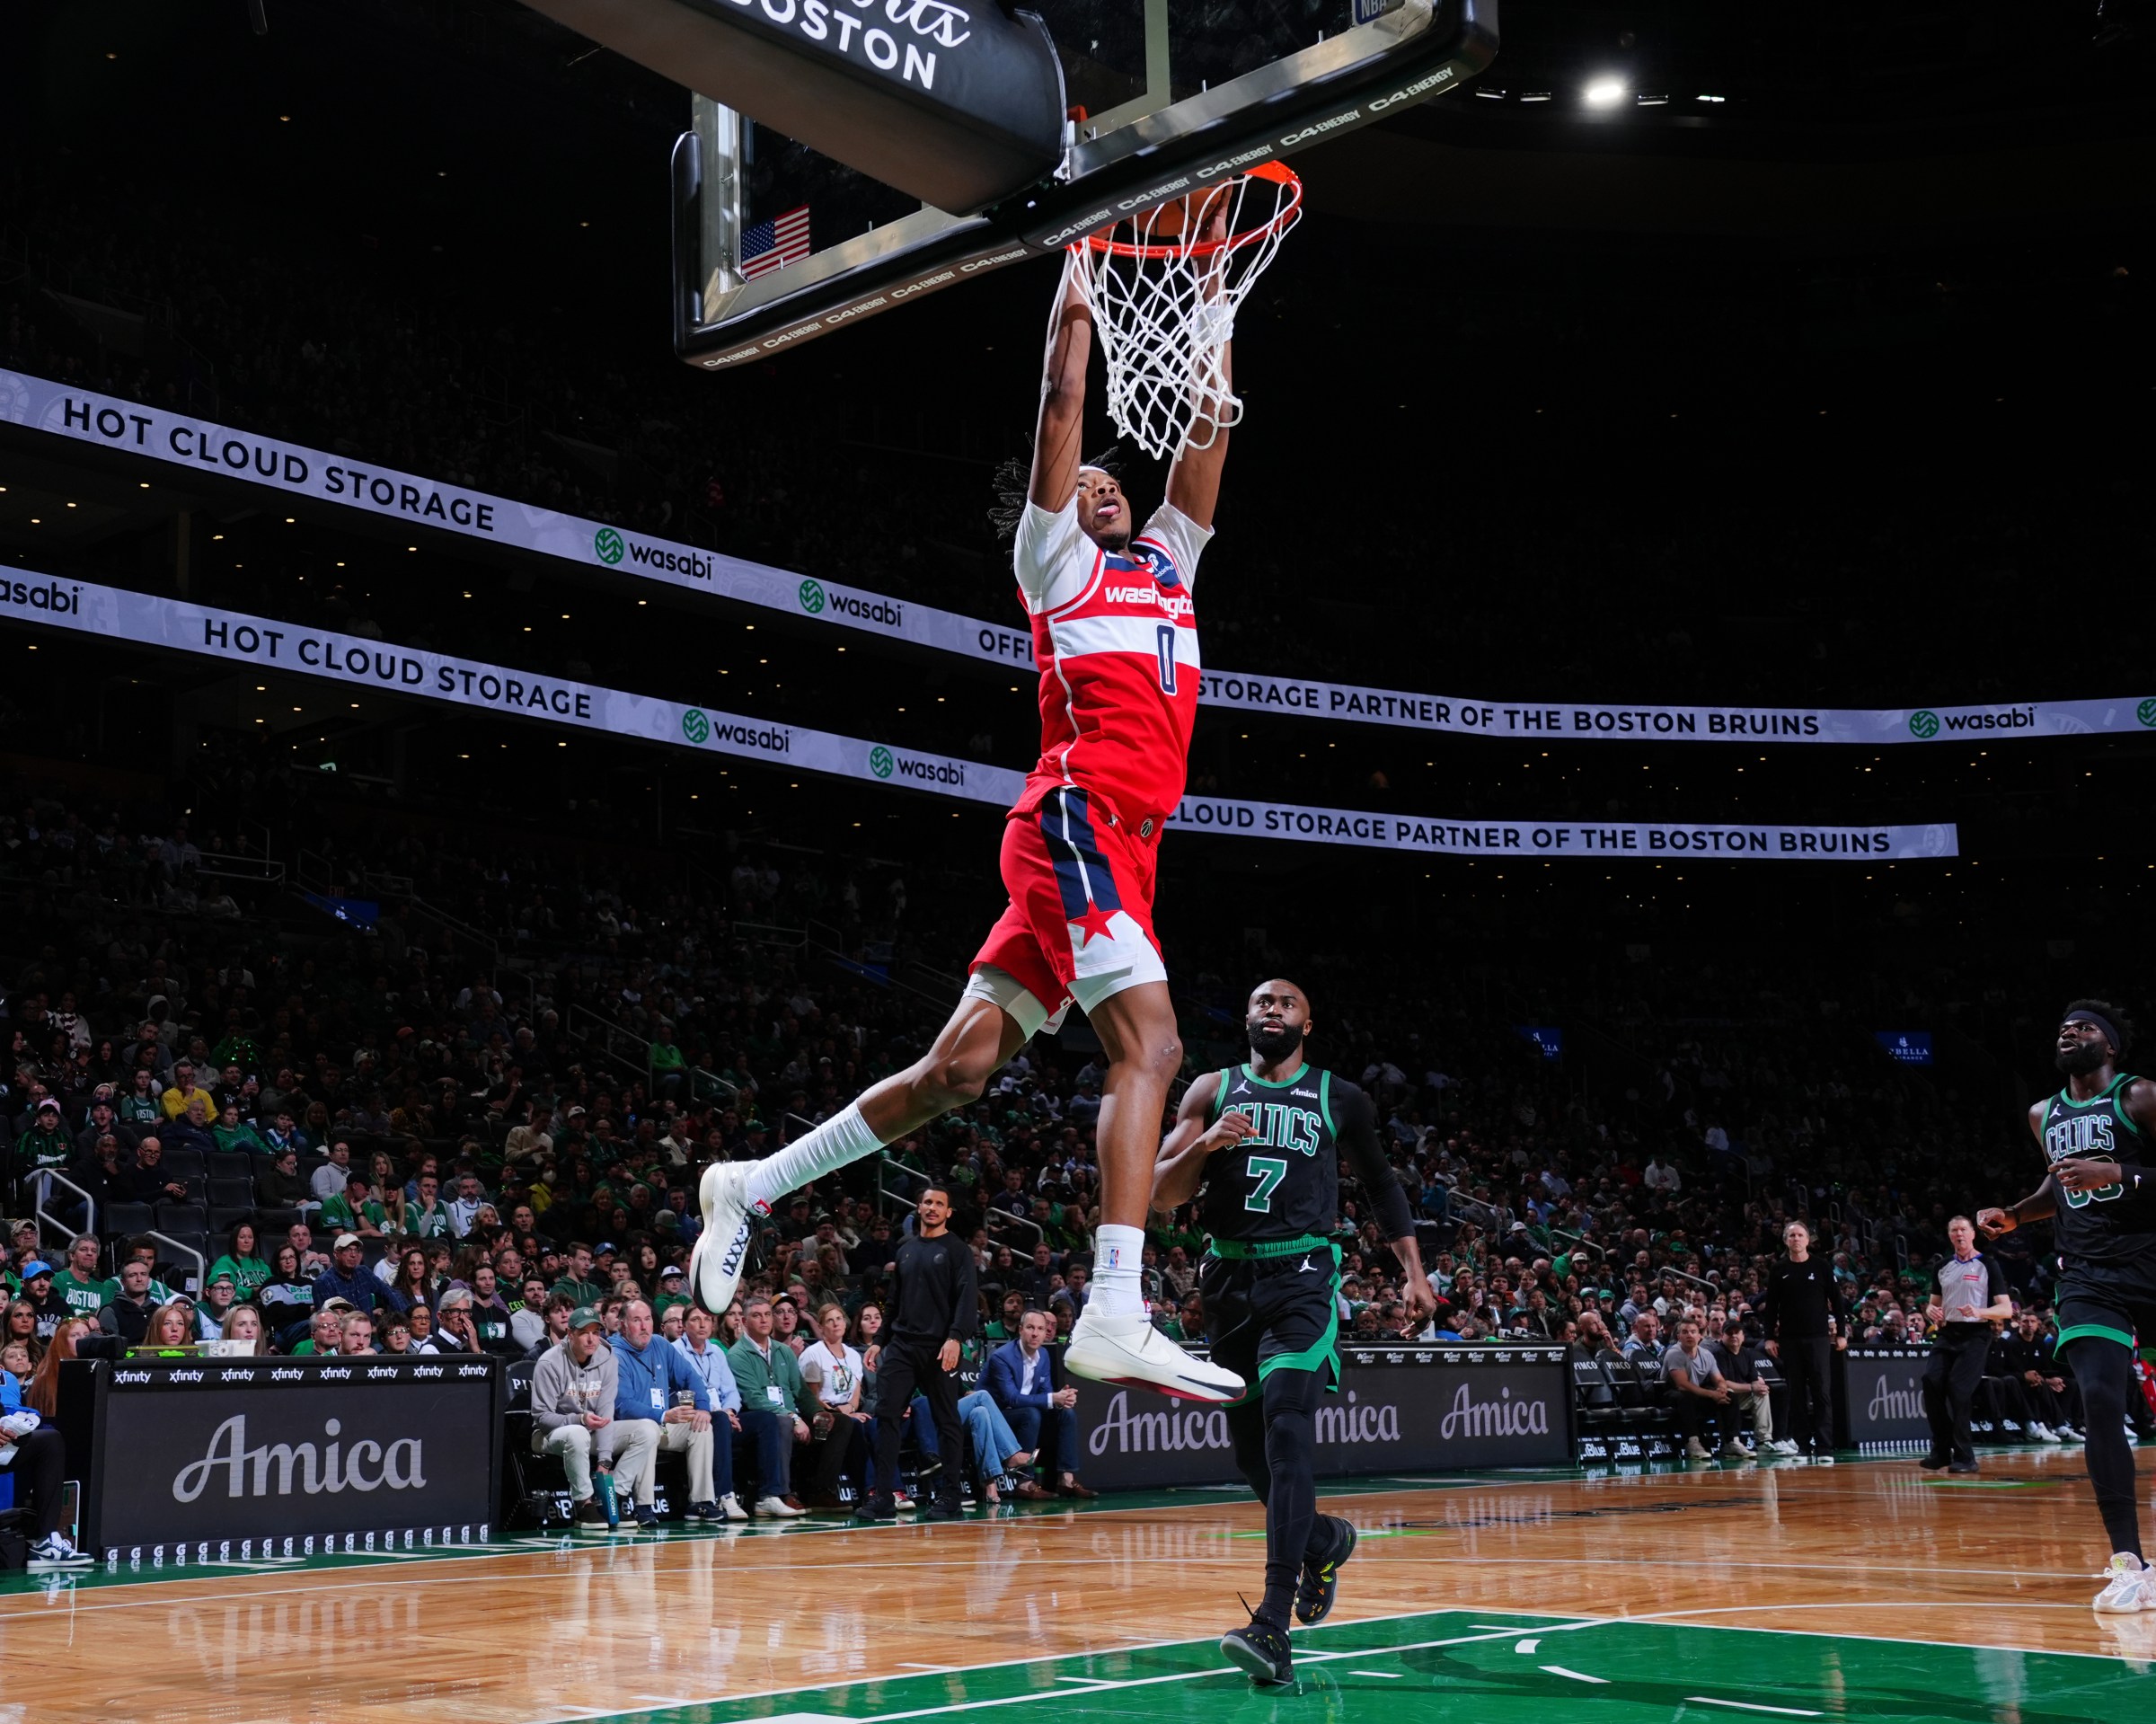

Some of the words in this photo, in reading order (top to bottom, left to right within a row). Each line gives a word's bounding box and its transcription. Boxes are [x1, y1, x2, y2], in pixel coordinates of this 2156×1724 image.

[730, 0, 936, 90] OSTON
[1368, 91, 1409, 112] C4
[1406, 66, 1454, 94] ENERGY
[1279, 127, 1319, 146] C4
[1316, 110, 1361, 134] ENERGY
[1196, 162, 1233, 180] C4
[1231, 145, 1274, 167] ENERGY
[1118, 194, 1153, 211] C4
[1150, 177, 1190, 199] ENERGY
[1043, 228, 1076, 246] C4
[1073, 208, 1112, 233] ENERGY
[959, 258, 992, 272] C4
[989, 248, 1028, 265] ENERGY
[891, 284, 922, 298] C4
[919, 270, 955, 288] ENERGY
[826, 311, 854, 323] C4
[853, 296, 887, 314] ENERGY
[763, 335, 791, 349] C4
[789, 323, 822, 339] ENERGY
[703, 357, 729, 367] C4
[729, 347, 760, 361] ENERGY
[65, 398, 152, 445] HOT
[170, 428, 308, 483] CLOUD
[325, 466, 494, 531] STORAGE
[630, 543, 712, 579] wasabi
[0, 579, 78, 614] asabi
[829, 592, 902, 627] wasabi
[979, 630, 1032, 662] OFFI
[1156, 623, 1178, 696] 0
[205, 619, 284, 658] HOT
[298, 639, 423, 685] CLOUD
[438, 667, 591, 719] STORAGE
[1330, 691, 1450, 723] PARTNER
[1461, 706, 1493, 727] OF
[1504, 710, 1561, 729] THE
[1574, 712, 1695, 732] BOSTON
[1709, 714, 1818, 735] BRUINS
[1945, 707, 2035, 730] wasabi
[714, 721, 789, 752] wasabi
[897, 758, 964, 786] wasabi
[1266, 810, 1385, 840] STORAGE
[1397, 822, 1520, 847] PARTNER
[1533, 829, 1569, 848] OF
[1581, 829, 1637, 849] THE
[1649, 831, 1767, 851] BOSTON
[1780, 833, 1890, 853] BRUINS
[1290, 1088, 1318, 1099] Amica
[2046, 1115, 2115, 1163] CELTICS
[1244, 1155, 1287, 1213] 7
[66, 1288, 101, 1309] BOSTON
[115, 1371, 151, 1384] xfinity
[169, 1369, 204, 1383] xfinity
[221, 1368, 254, 1381] xfinity
[271, 1367, 304, 1380] xfinity
[320, 1366, 351, 1379] xfinity
[367, 1366, 398, 1379] xfinity
[413, 1366, 443, 1378] xfinity
[458, 1365, 488, 1377] xfinity
[1574, 1361, 1597, 1370] PIMCO
[1606, 1361, 1630, 1370] PIMCO
[1638, 1361, 1661, 1369] PIMCO
[1441, 1384, 1549, 1440] Amica
[1869, 1375, 1927, 1420] Amic
[1089, 1389, 1231, 1456] Amica
[1315, 1390, 1402, 1445] mica
[172, 1414, 427, 1503] Amica
[608, 1486, 616, 1516] POPCORN
